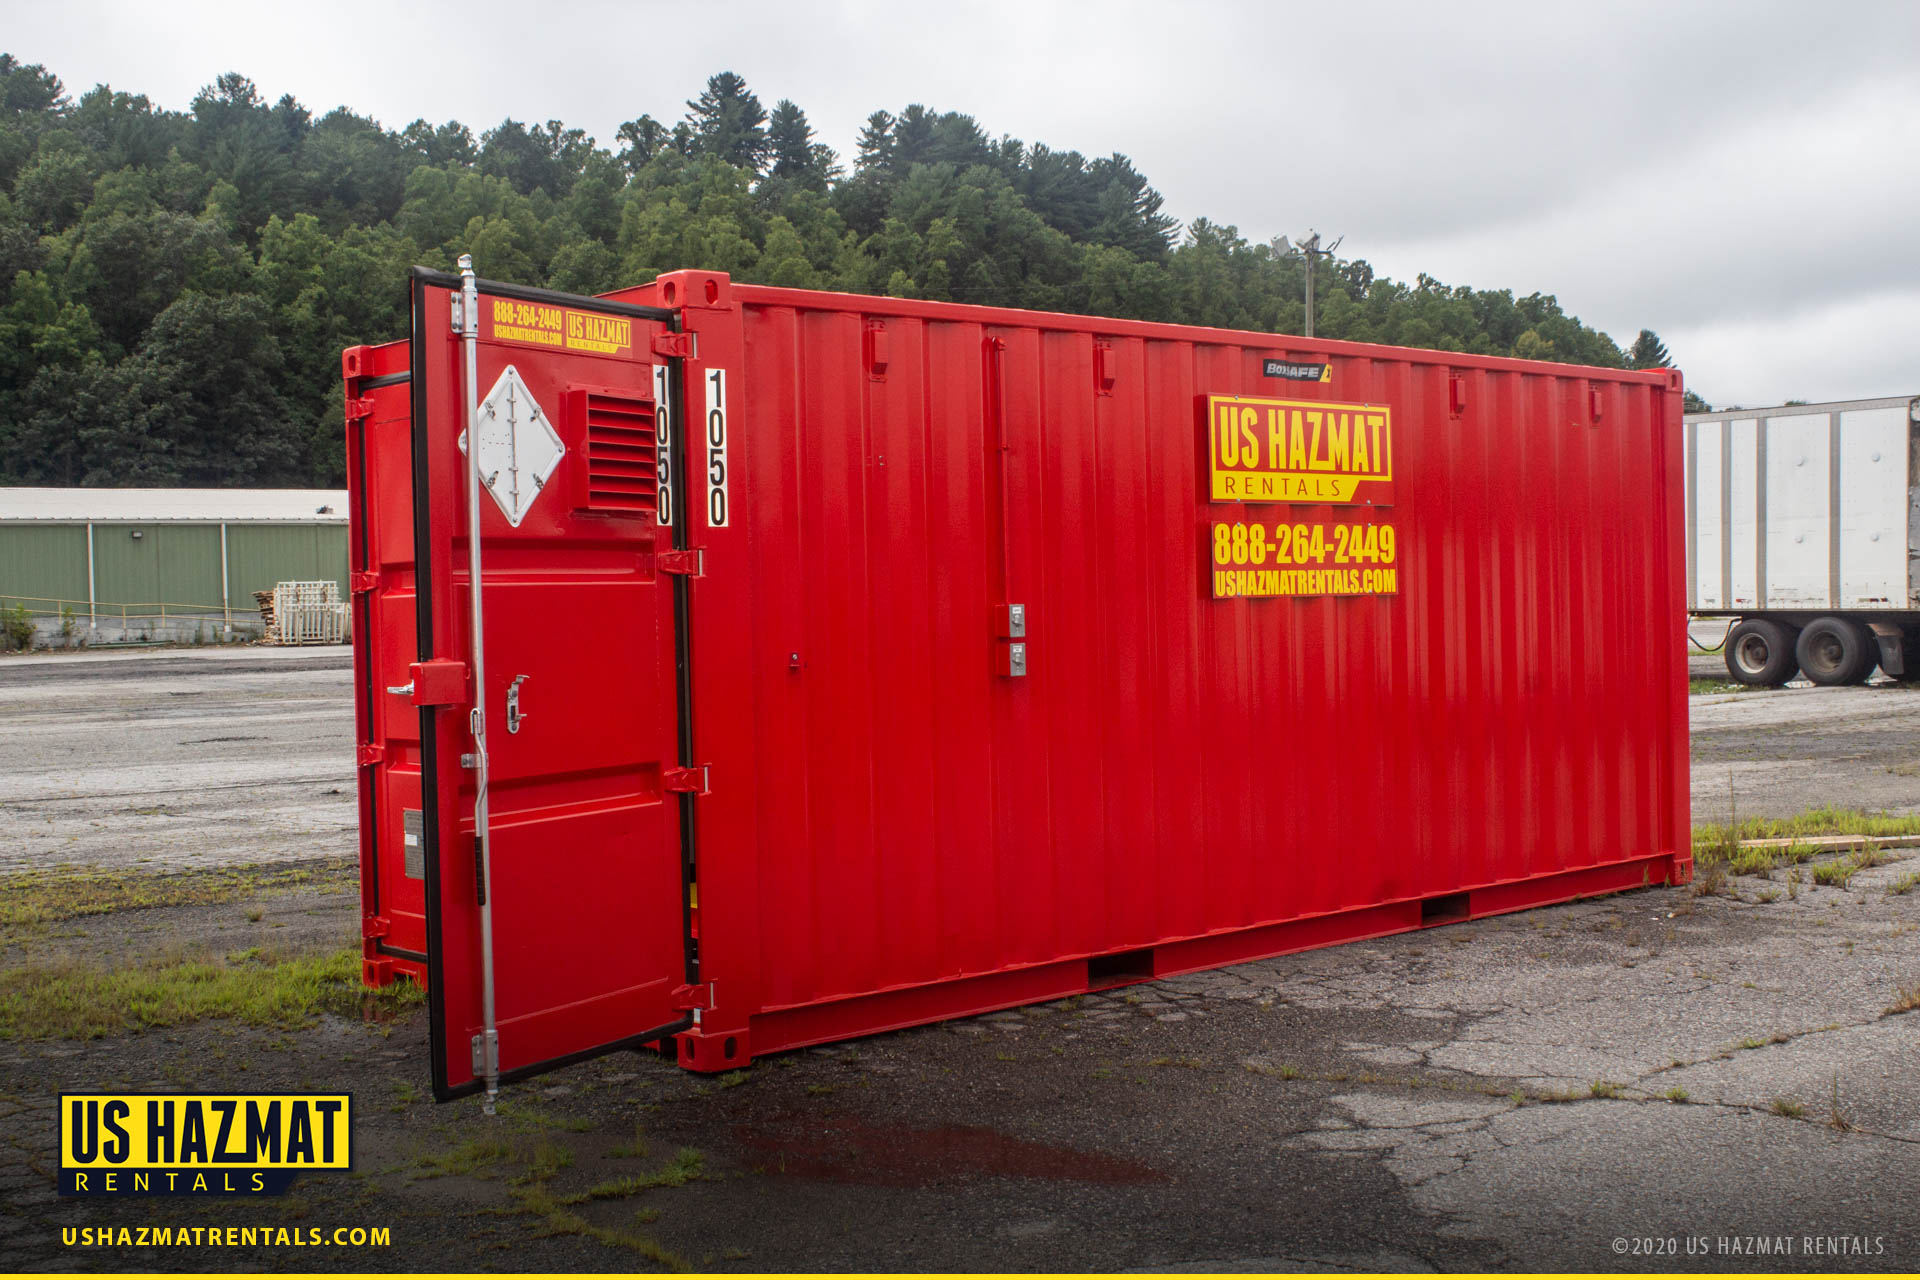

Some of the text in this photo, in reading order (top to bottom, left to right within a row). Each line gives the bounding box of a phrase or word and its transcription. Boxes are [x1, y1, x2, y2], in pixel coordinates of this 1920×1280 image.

[494, 301, 562, 331] 888-264-2449
[569, 315, 628, 345] US HAZMAT
[494, 324, 562, 346] USHAZMATRENTALS.COM
[570, 339, 612, 351] RENTALS
[656, 367, 670, 525] 1050
[709, 370, 725, 526] 1050
[1220, 406, 1384, 473] US HAZMAT
[1225, 476, 1341, 496] RENTALS
[1214, 523, 1395, 565] 888-264-2449
[1215, 569, 1396, 596] USHAZMATRENTALS.COM
